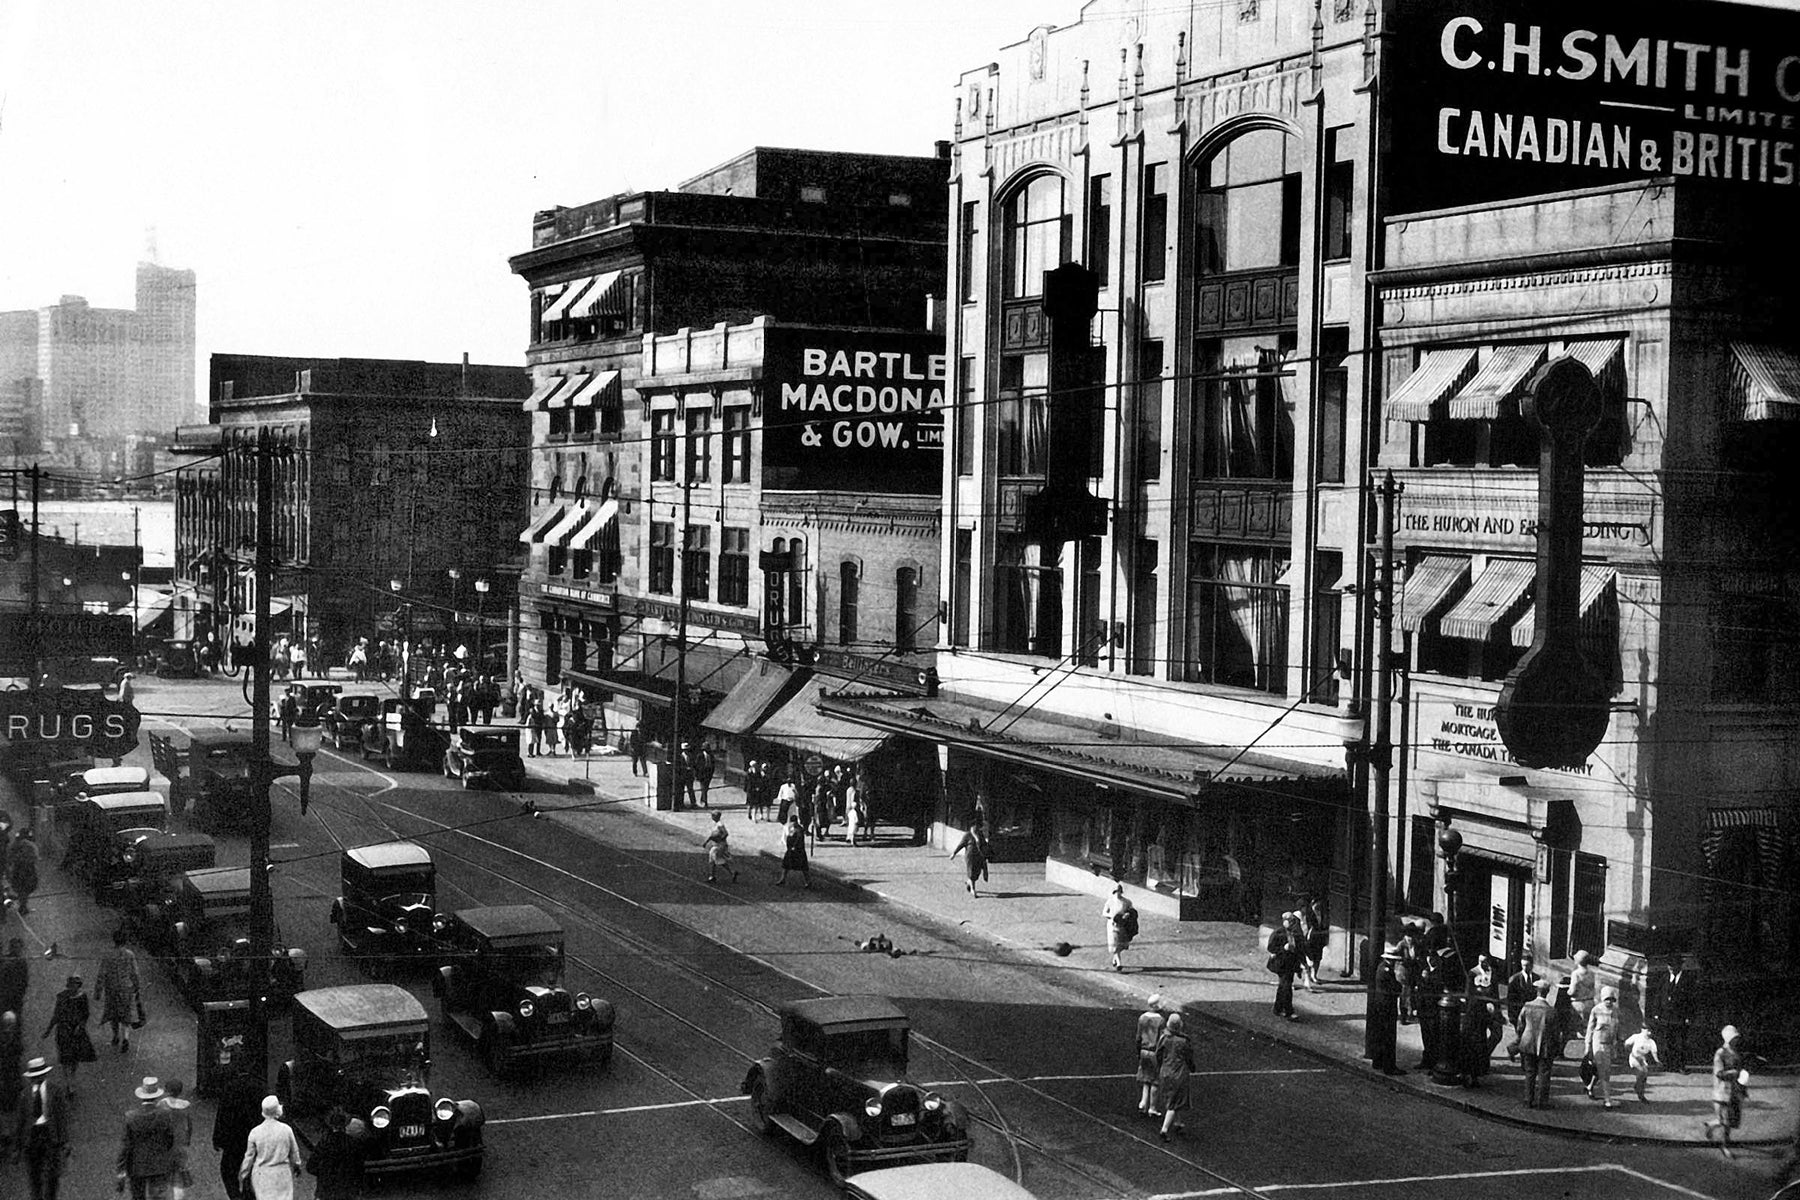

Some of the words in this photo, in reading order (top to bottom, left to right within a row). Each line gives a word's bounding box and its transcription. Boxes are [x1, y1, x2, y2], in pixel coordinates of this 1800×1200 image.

[1437, 107, 1631, 170] CANADIAN
[1640, 139, 1662, 172] &
[1672, 131, 1800, 185] BRITIS
[801, 420, 822, 447] &
[832, 420, 910, 449] GOW.
[1403, 513, 1430, 532] THE
[1433, 515, 1480, 534] HURON
[1483, 516, 1514, 535] AND
[1453, 702, 1474, 718] THE
[8, 714, 125, 739] RUGS
[1441, 720, 1497, 741] MORTGAGE
[1455, 742, 1498, 761] CANADA
